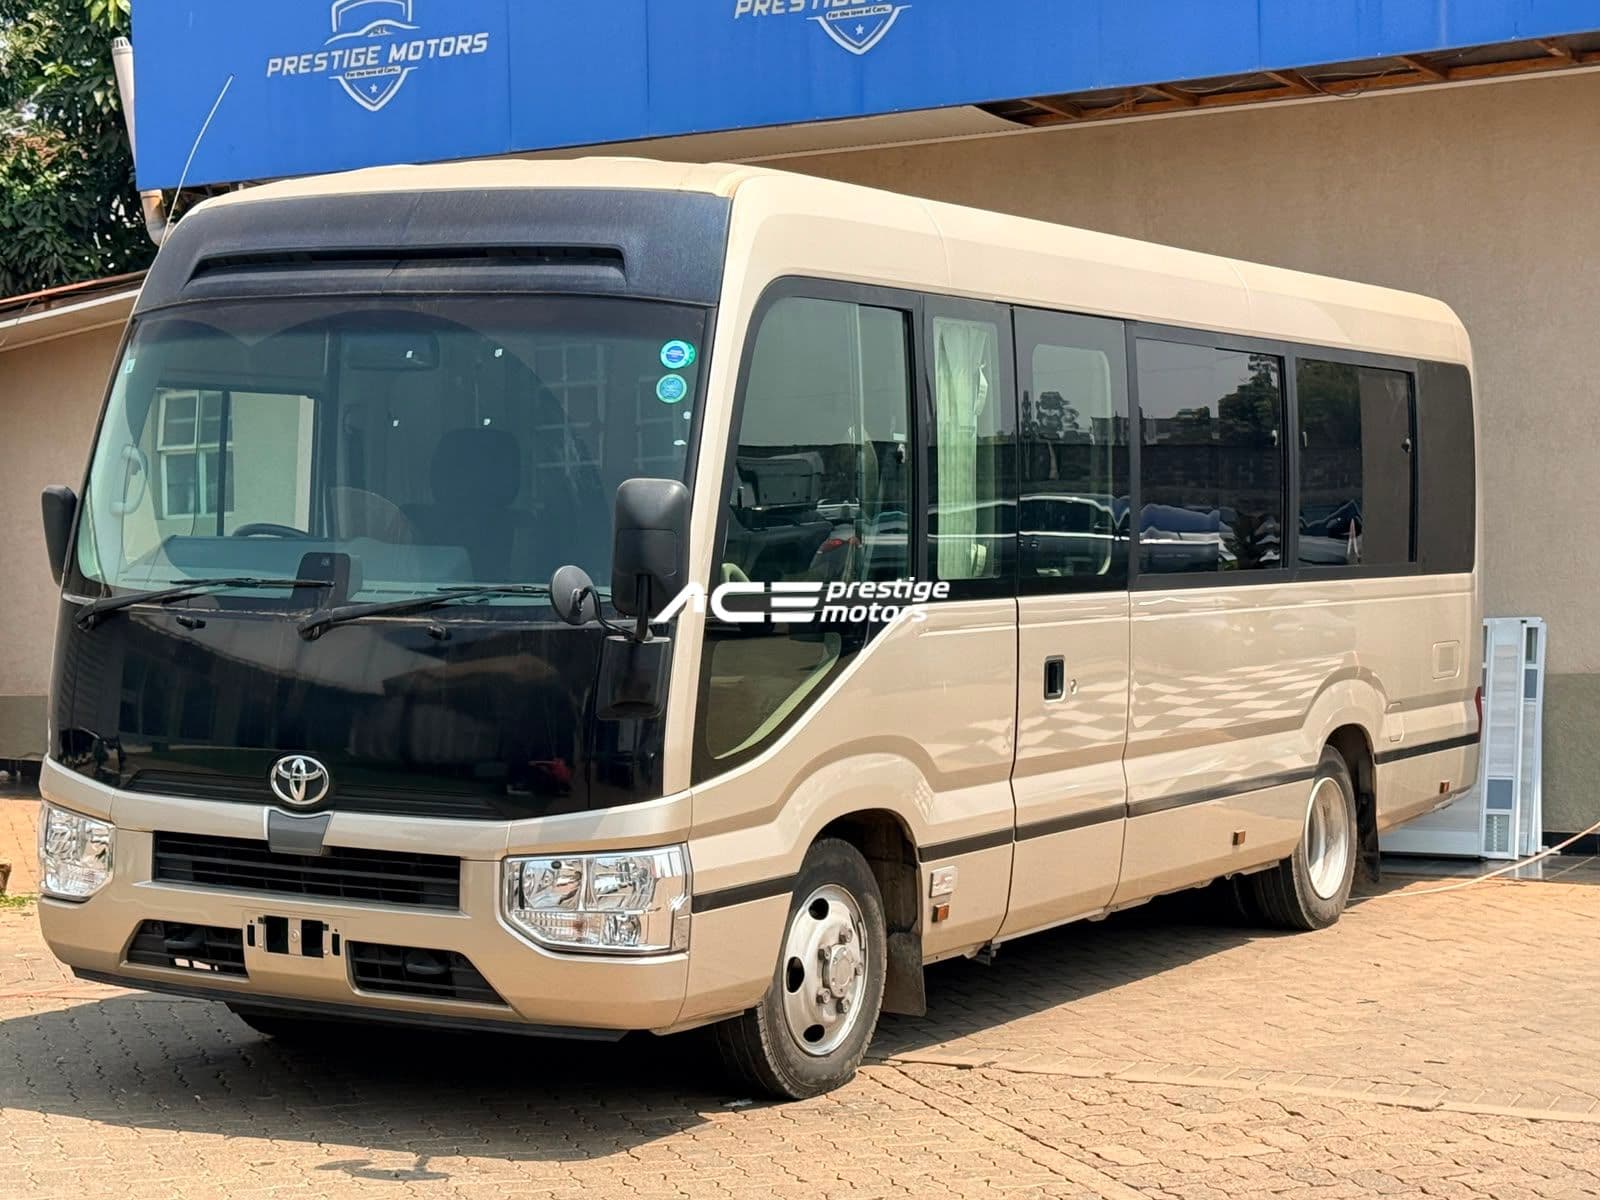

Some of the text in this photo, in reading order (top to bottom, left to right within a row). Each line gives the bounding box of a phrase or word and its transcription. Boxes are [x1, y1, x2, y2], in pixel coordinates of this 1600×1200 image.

[734, 0, 866, 19] PRES
[266, 32, 489, 78] PRESTIGE MOTORS
